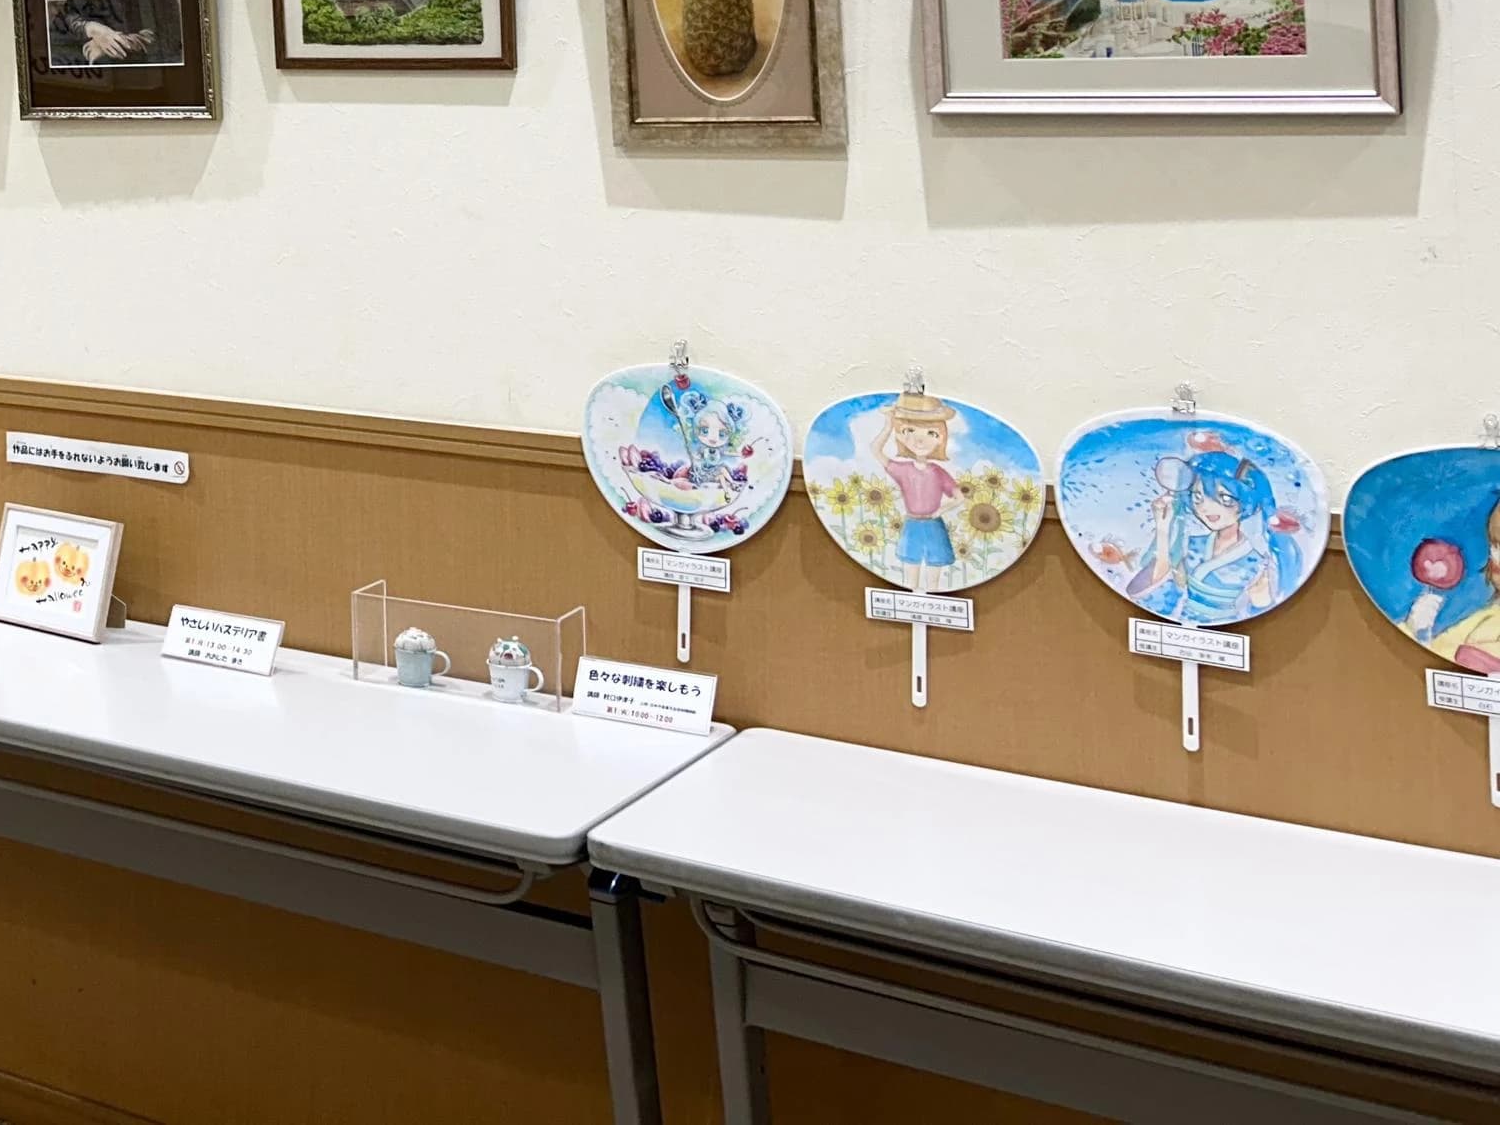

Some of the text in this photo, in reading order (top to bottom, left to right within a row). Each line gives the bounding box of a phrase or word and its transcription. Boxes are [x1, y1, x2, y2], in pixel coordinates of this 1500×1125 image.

[12, 443, 170, 474] 作品にはお手をふれないようお願い致します
[1165, 630, 1240, 651] マンガイラスト講座
[588, 669, 701, 698] 色々な刺繍を楽しもう
